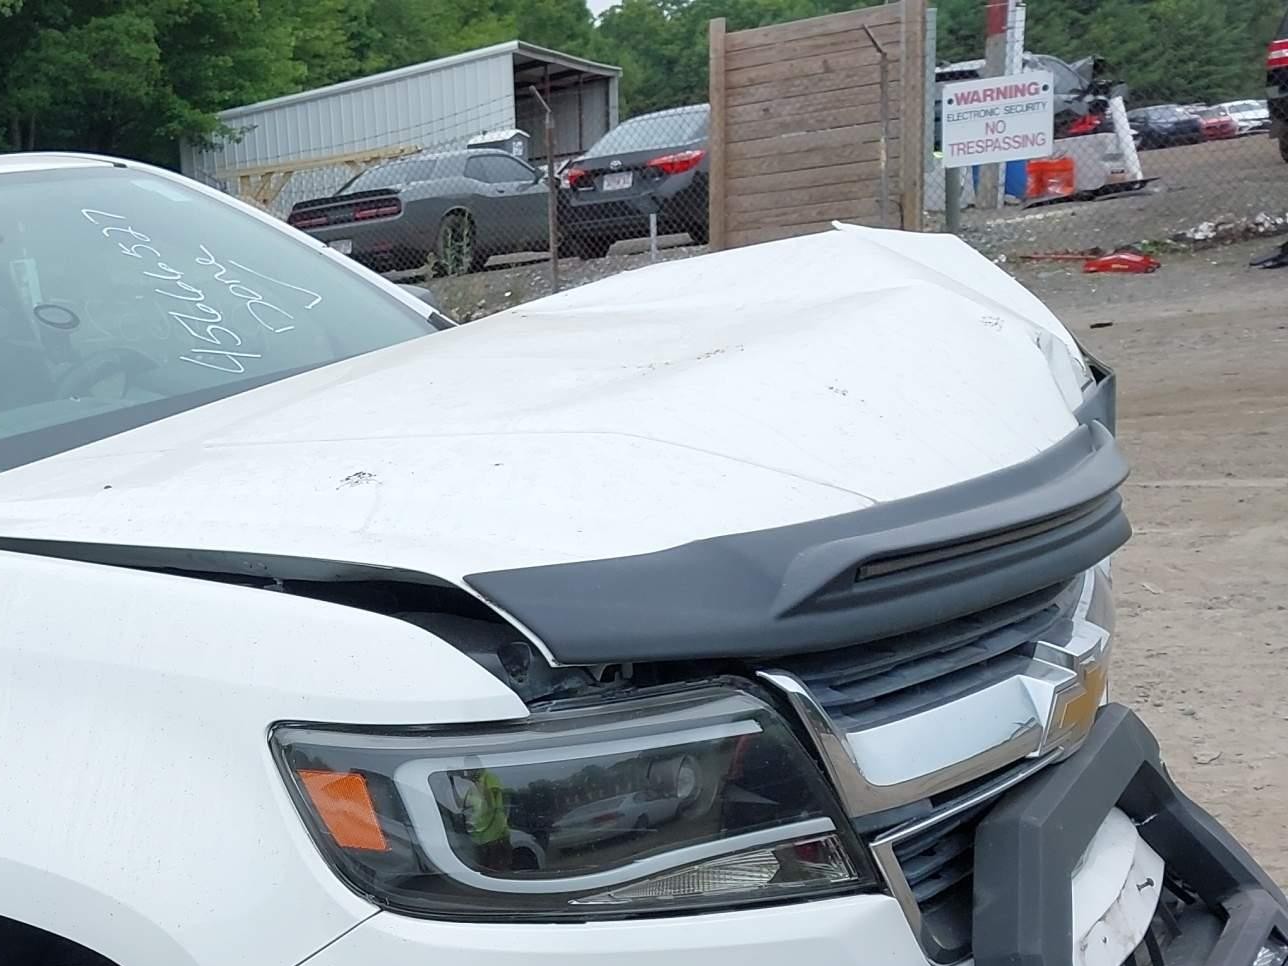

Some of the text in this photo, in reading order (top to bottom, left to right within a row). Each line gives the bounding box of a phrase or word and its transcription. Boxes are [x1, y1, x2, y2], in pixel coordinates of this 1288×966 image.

[953, 82, 1041, 106] WARNING
[946, 101, 1049, 123] ELECTRONIC SECURITY
[984, 119, 1007, 135] NO
[948, 132, 1047, 156] TRESPASSING
[80, 207, 262, 374] 45666527
